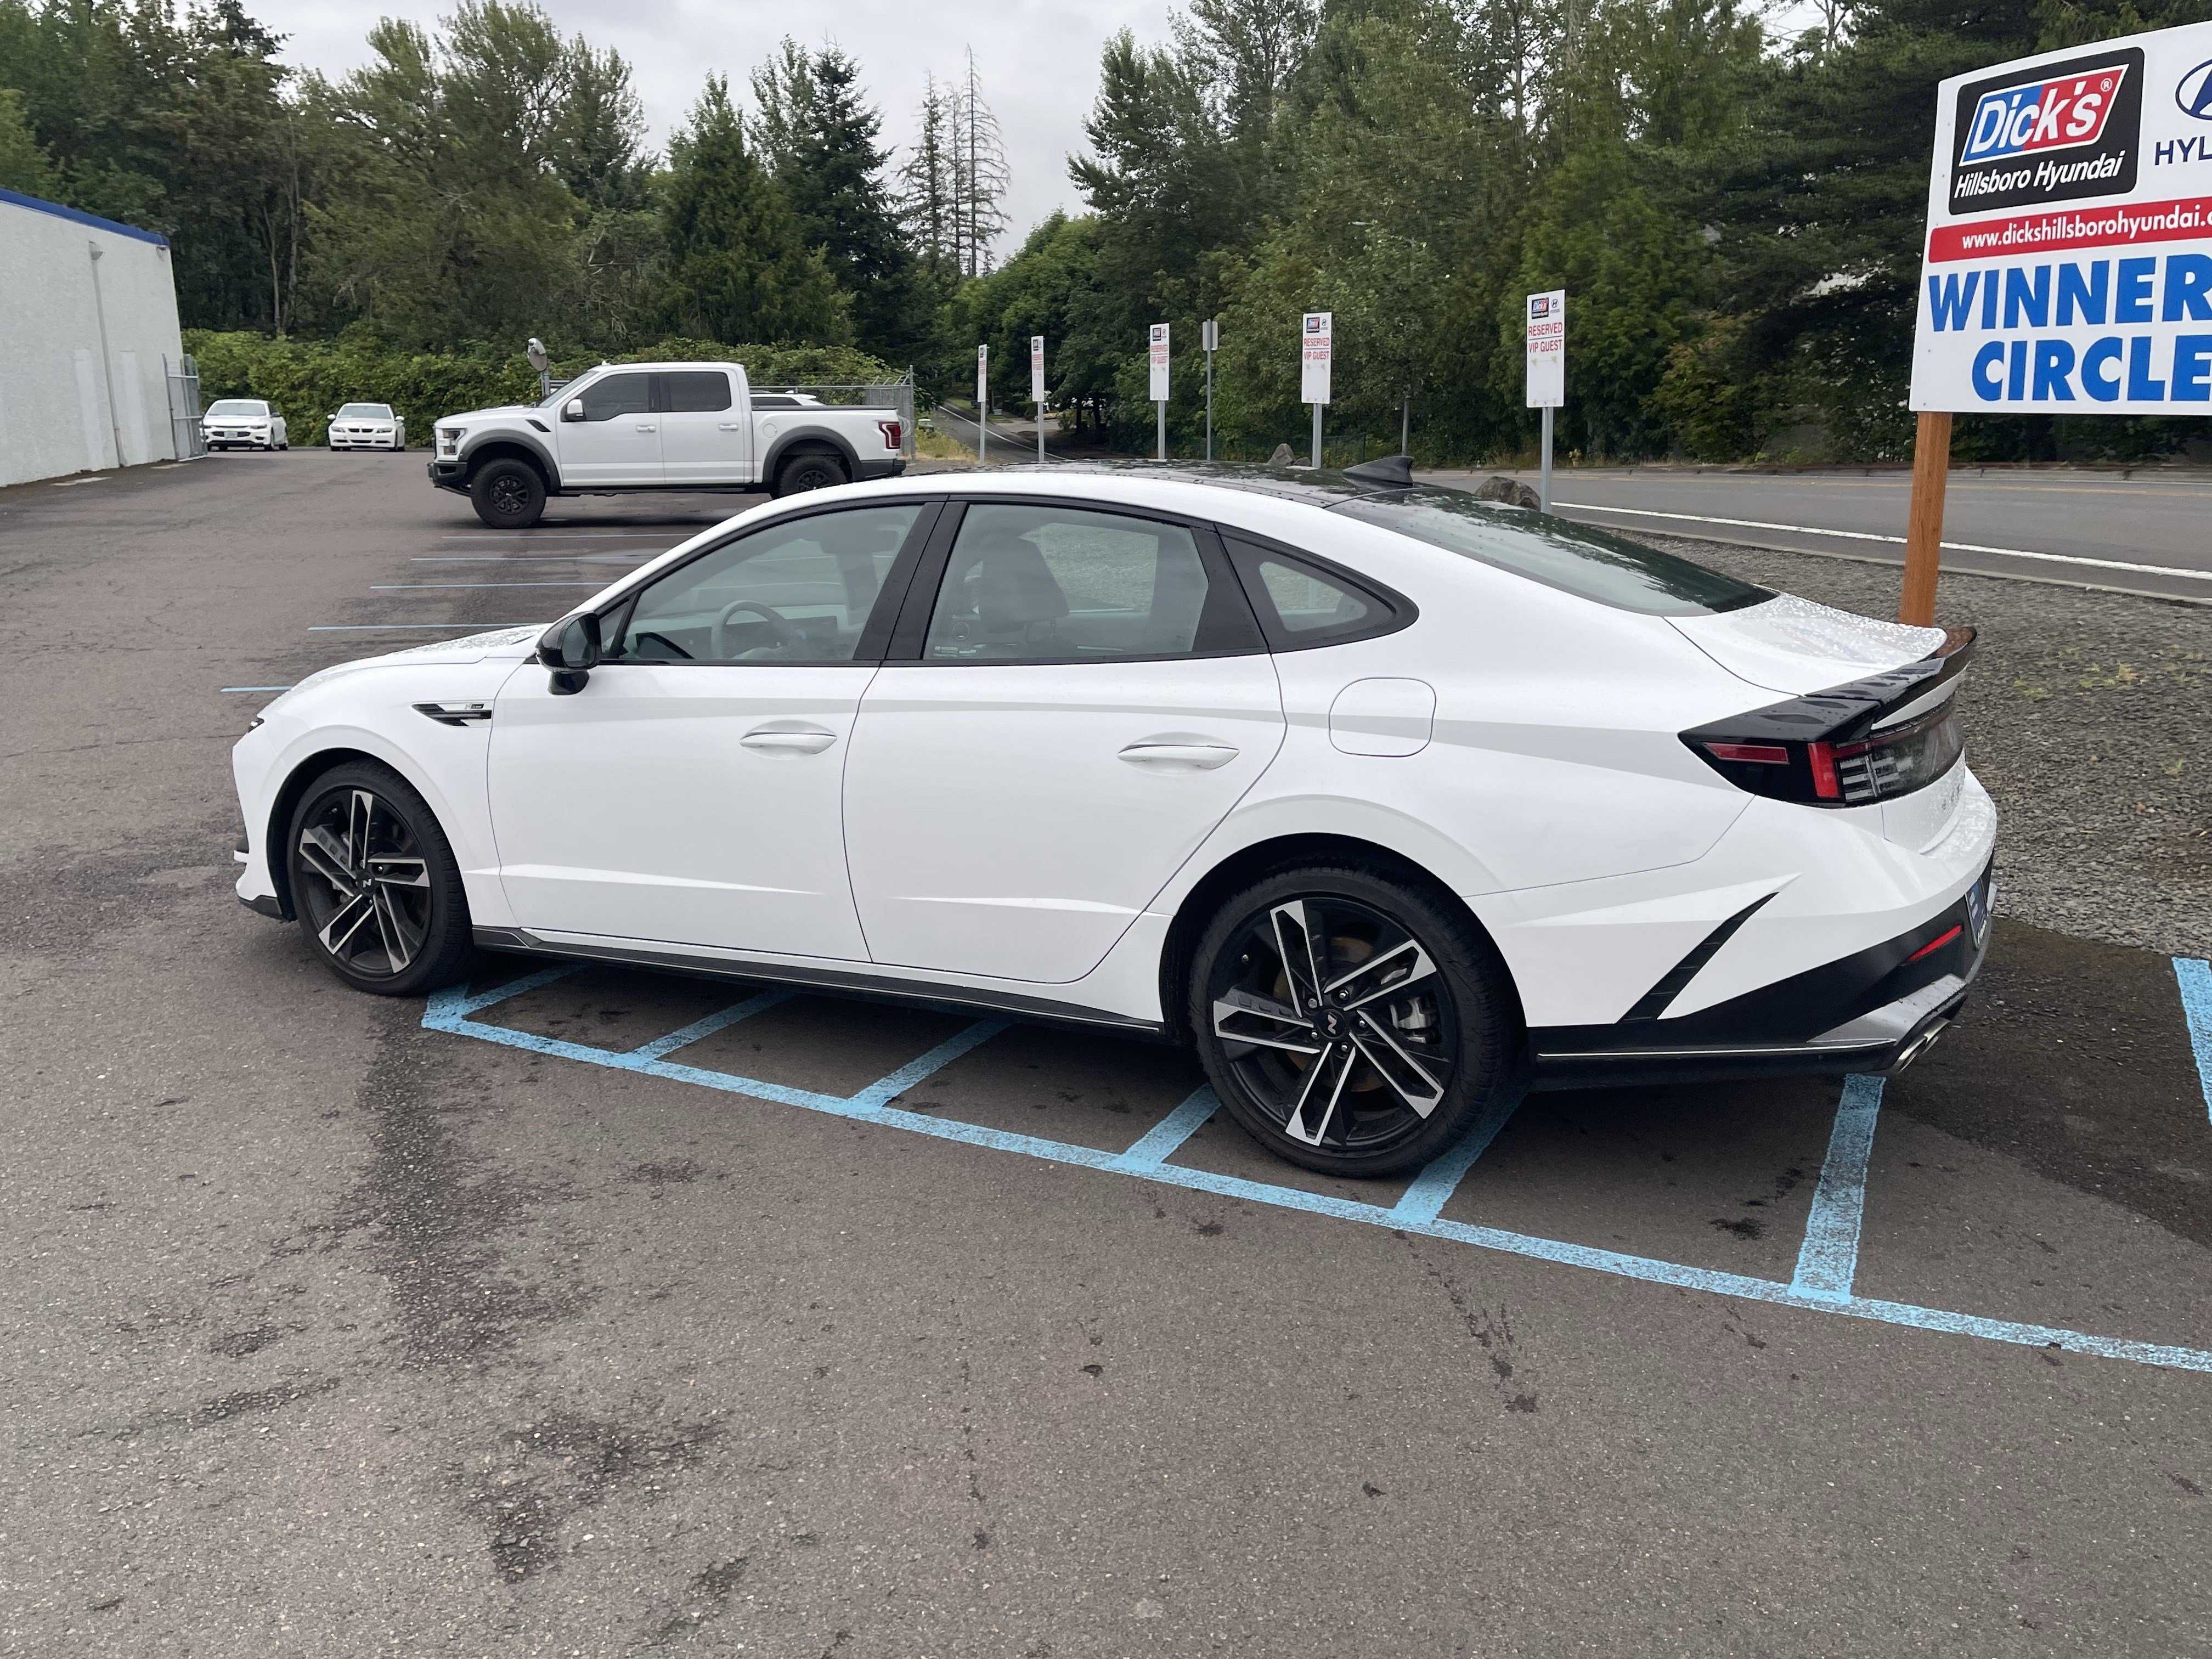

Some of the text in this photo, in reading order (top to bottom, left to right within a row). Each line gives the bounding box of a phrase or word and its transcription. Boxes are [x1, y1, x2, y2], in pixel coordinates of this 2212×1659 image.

[1954, 150, 2126, 199] Hillsboro Hyundai
[1928, 254, 2212, 331] WINNER
[1528, 321, 1562, 337] RESERVED
[1304, 337, 1330, 346] RESERVED
[1528, 339, 1562, 353] VIP GUEST
[1313, 351, 1329, 360] GUEST
[1972, 336, 2212, 401] CIRCLE
